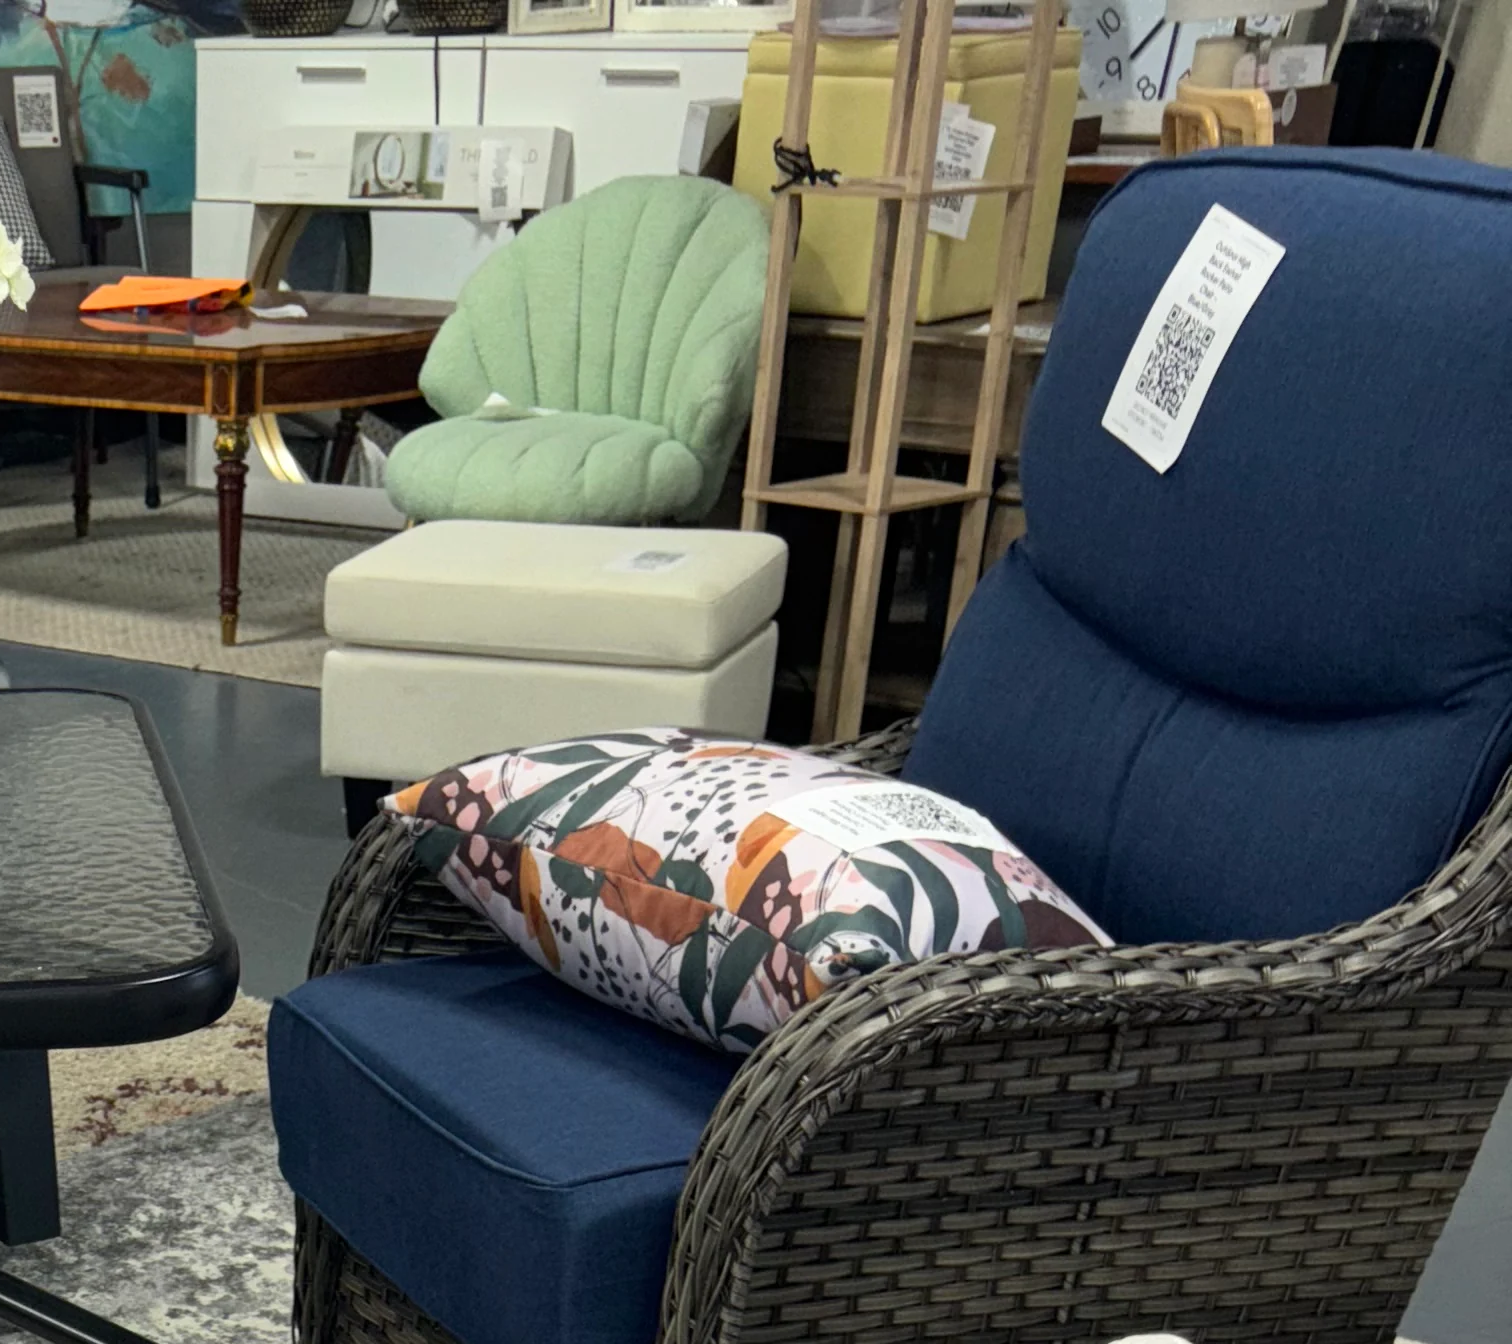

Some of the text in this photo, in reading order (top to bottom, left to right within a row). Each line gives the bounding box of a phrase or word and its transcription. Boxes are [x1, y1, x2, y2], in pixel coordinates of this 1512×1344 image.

[1096, 7, 1121, 39] 10
[1106, 56, 1122, 81] 9
[1136, 75, 1157, 101] 8
[1209, 254, 1224, 269] Back
[1216, 240, 1238, 261] Outdoor
[1199, 283, 1214, 299] Chair
[1200, 266, 1233, 295] Rocker Patio
